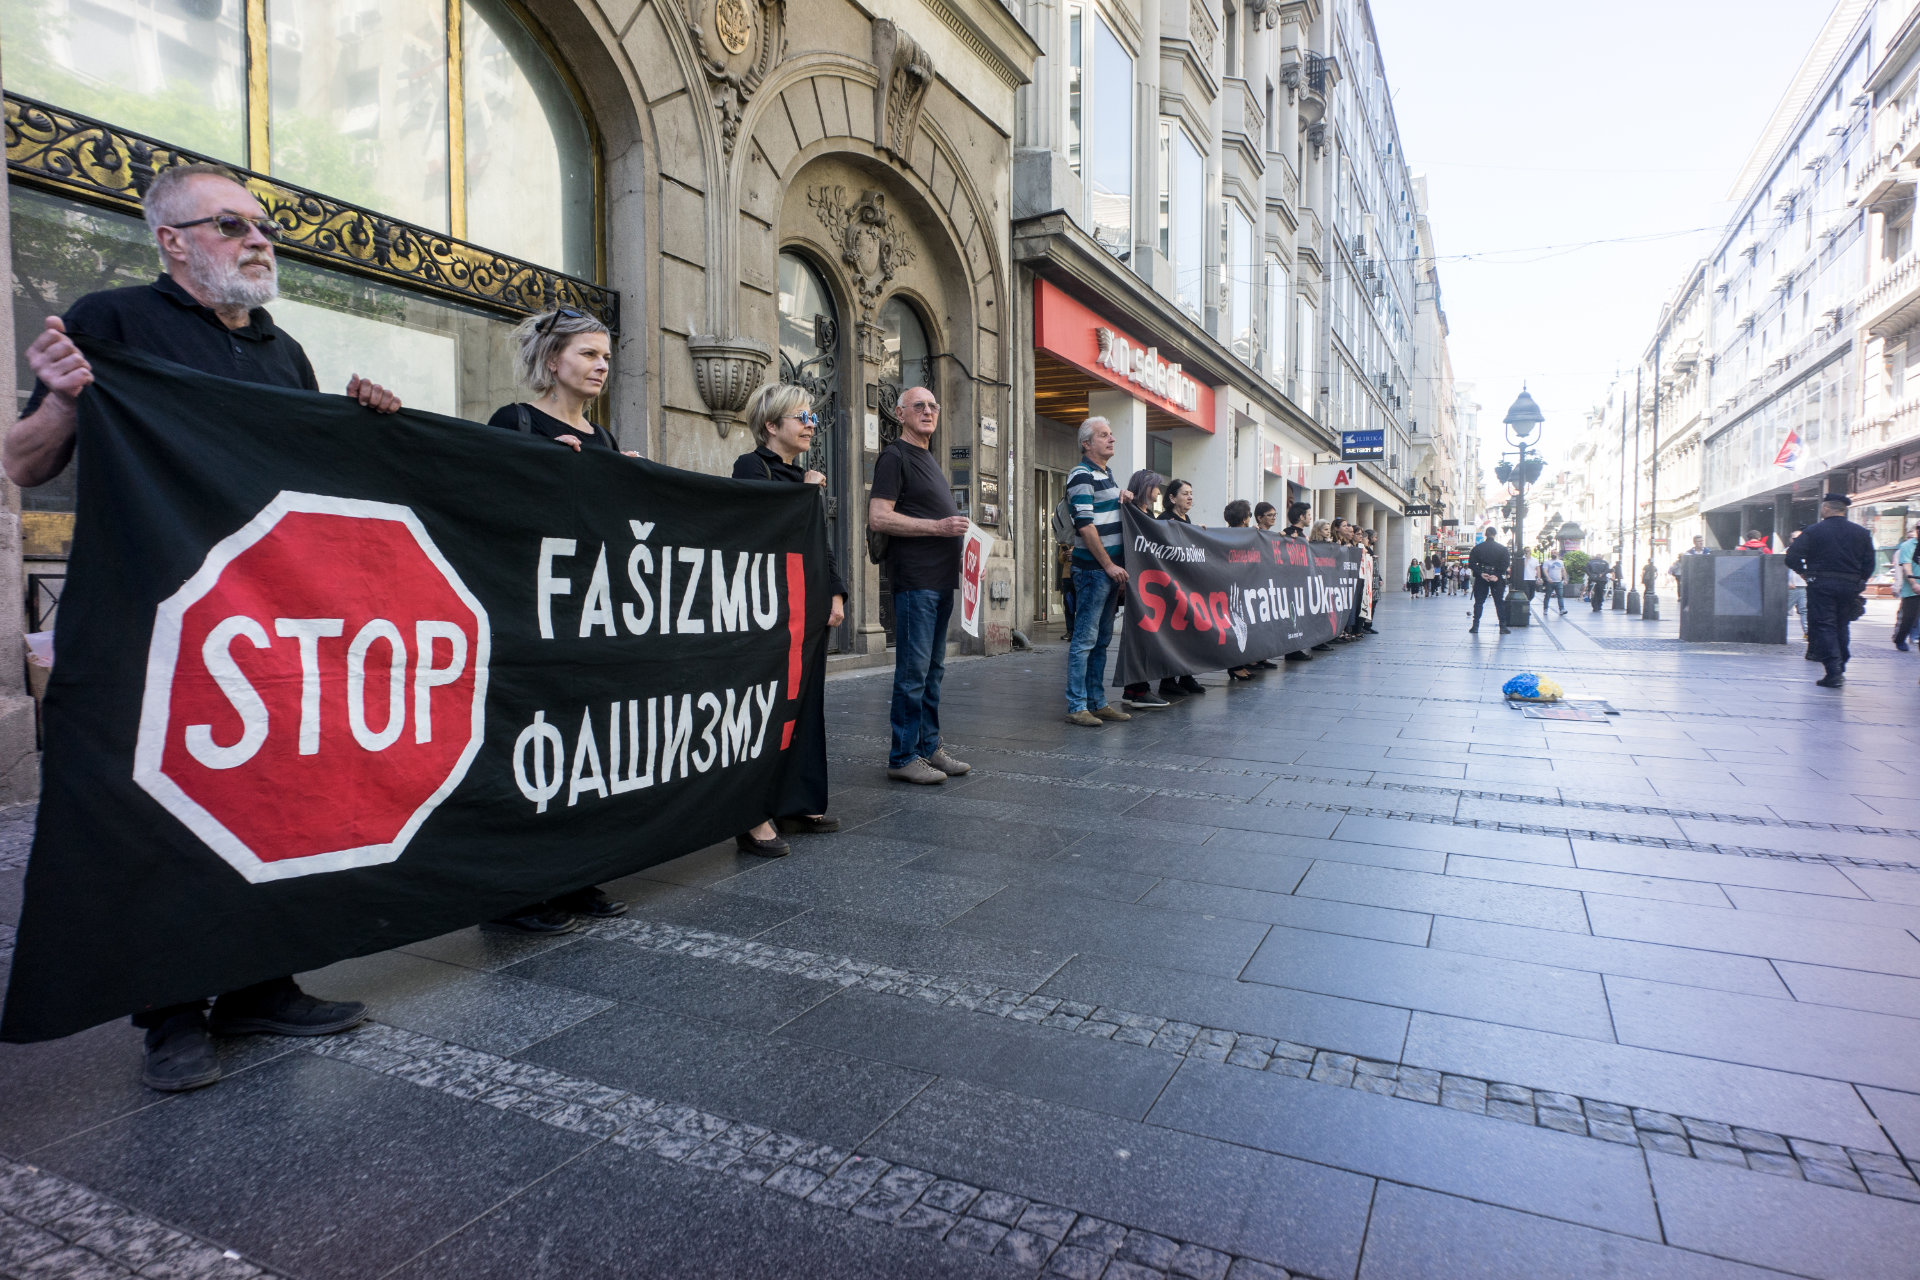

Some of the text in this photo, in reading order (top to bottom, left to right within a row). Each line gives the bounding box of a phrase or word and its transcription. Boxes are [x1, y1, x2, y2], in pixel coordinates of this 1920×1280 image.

[1334, 467, 1353, 486] A1
[537, 519, 779, 639] FAŠIZMU
[1137, 568, 1232, 645] Stop
[184, 614, 468, 770] STOP
[513, 681, 779, 813] ФАШИЗМУ
